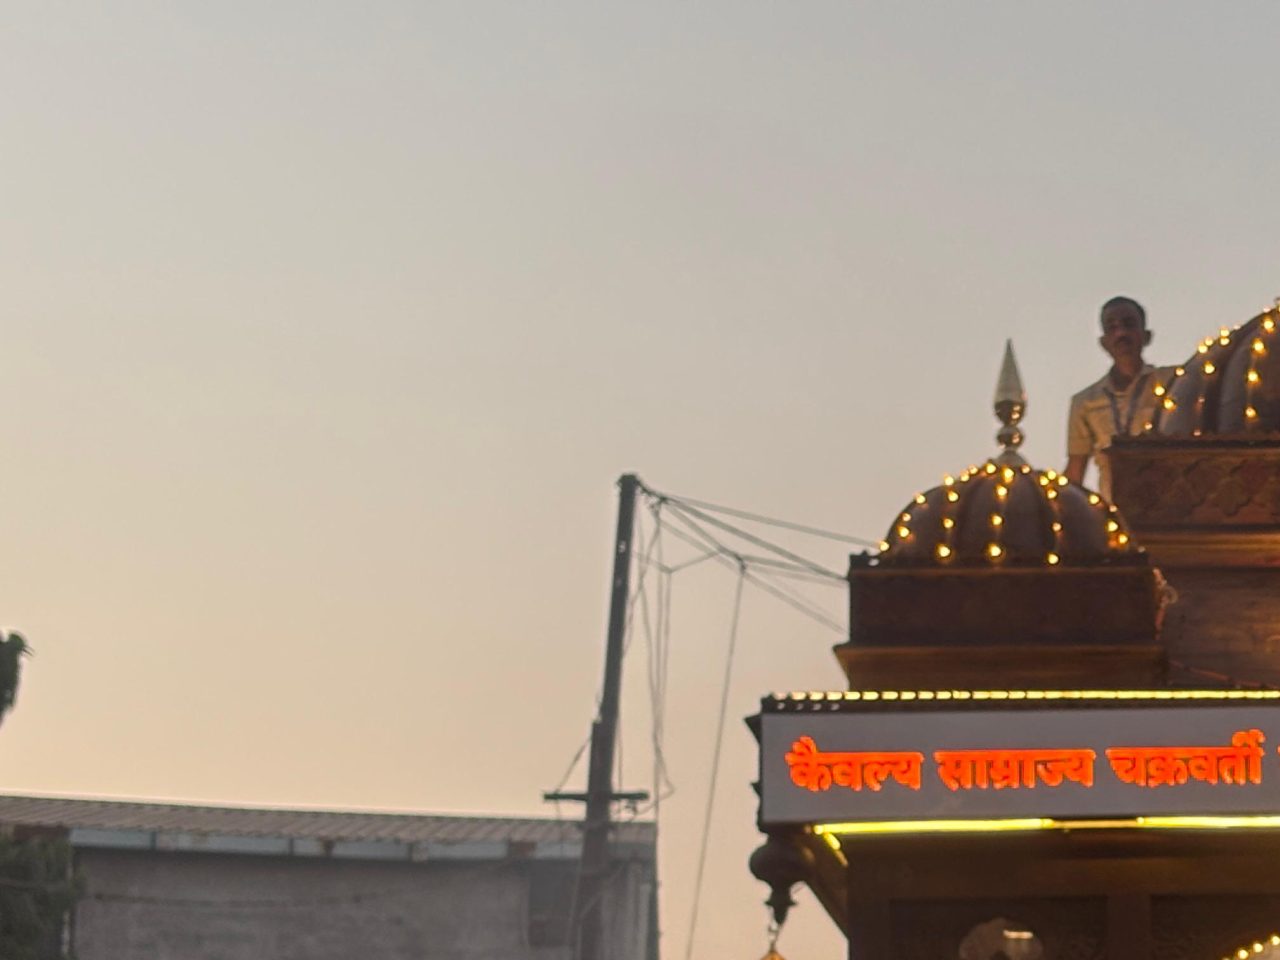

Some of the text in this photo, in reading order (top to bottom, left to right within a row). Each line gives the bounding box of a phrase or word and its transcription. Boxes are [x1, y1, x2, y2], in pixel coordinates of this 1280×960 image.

[784, 736, 925, 792] कैवल्य
[933, 748, 1096, 791] साम्राज्य
[1105, 728, 1266, 788] चक्रवर्ती
